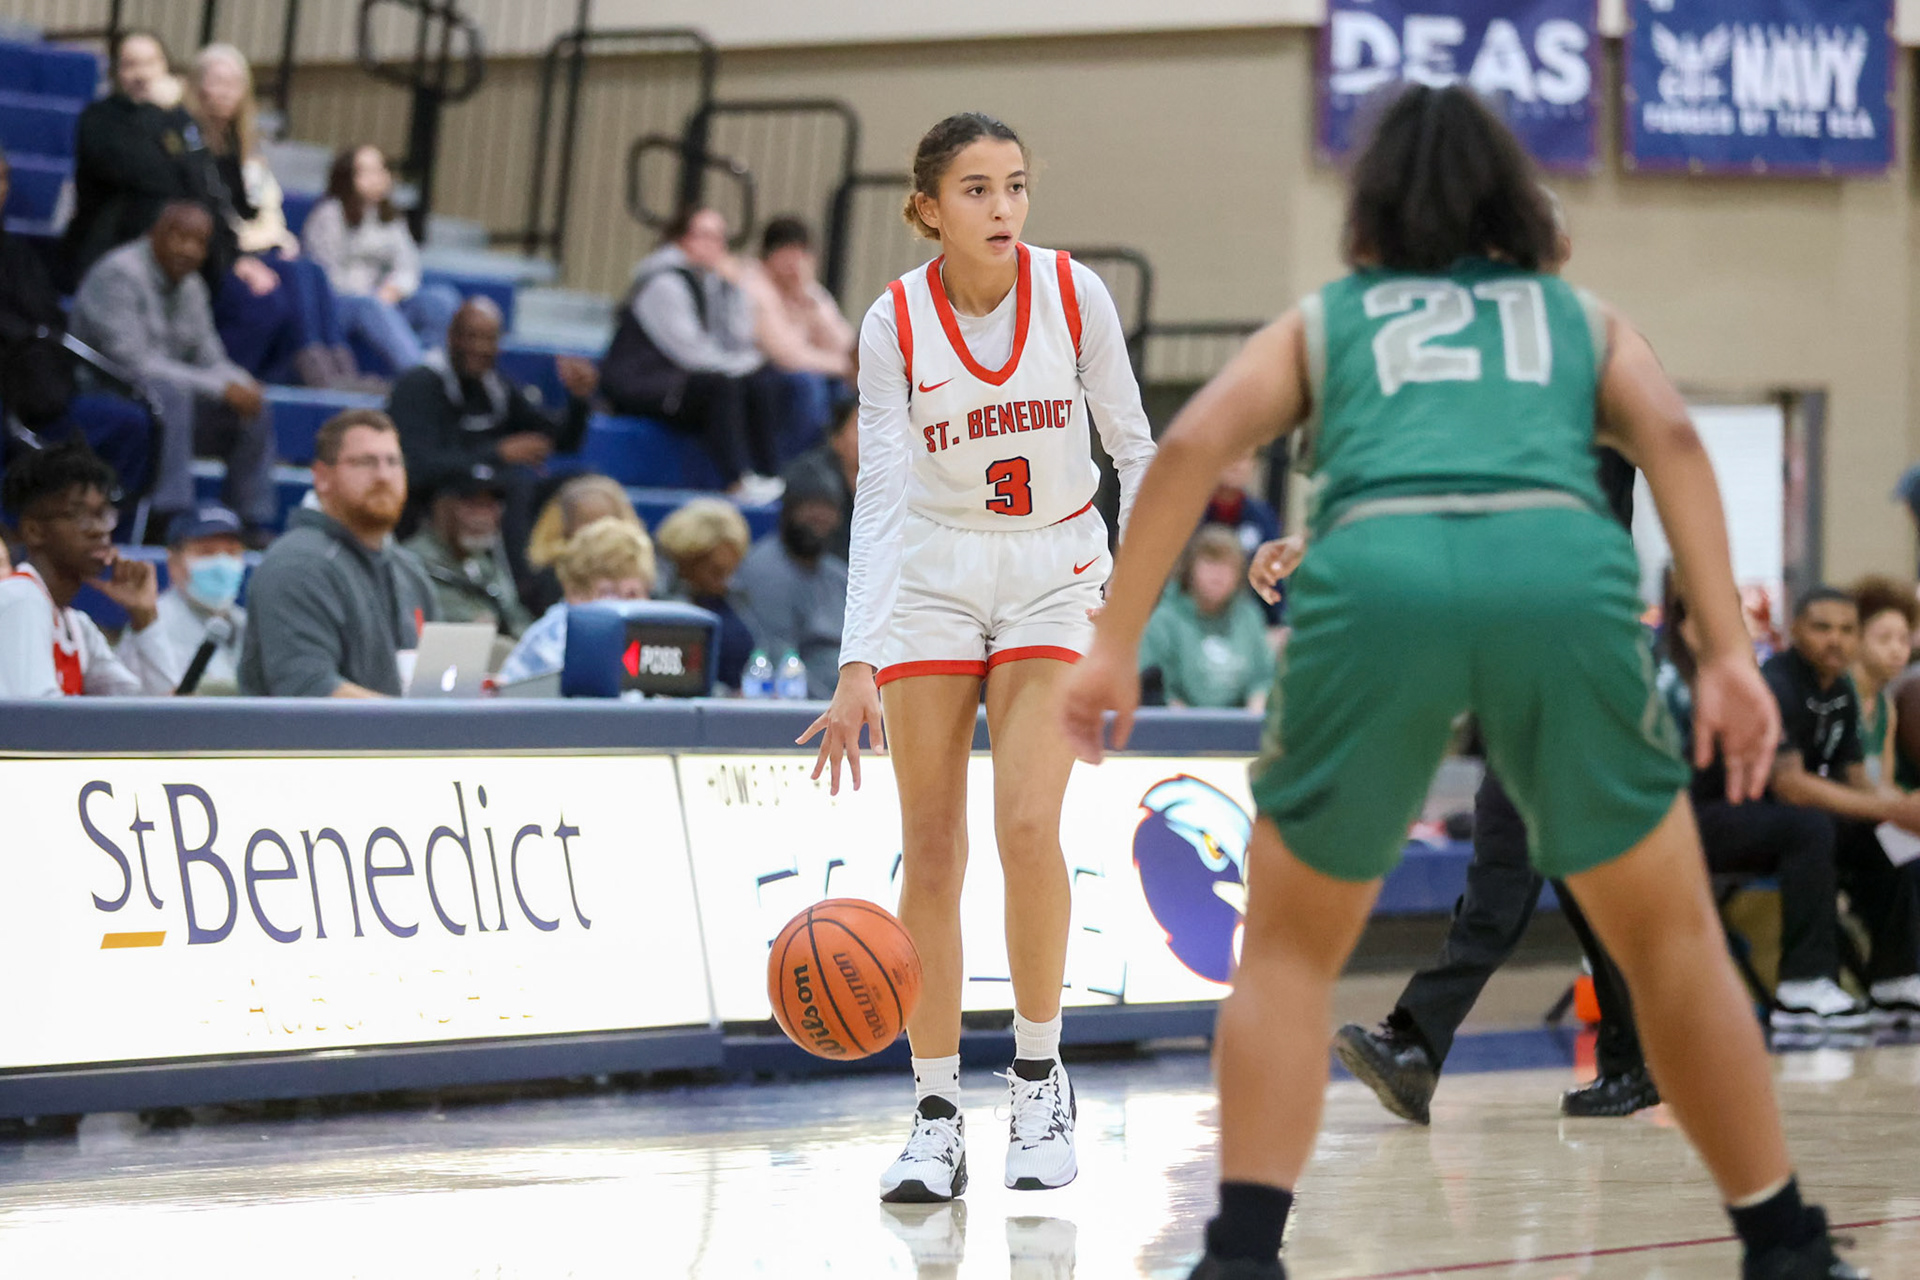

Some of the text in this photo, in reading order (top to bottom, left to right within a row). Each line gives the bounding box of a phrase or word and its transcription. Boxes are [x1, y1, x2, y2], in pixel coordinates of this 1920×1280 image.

[1330, 10, 1592, 104] DEAS
[1732, 22, 1868, 111] NAVY
[1363, 276, 1553, 396] 21
[923, 399, 1073, 453] ST. BENEDICT
[985, 455, 1033, 516] 3
[793, 964, 847, 1055] Wilson
[832, 951, 886, 1040] EVOLUTION
